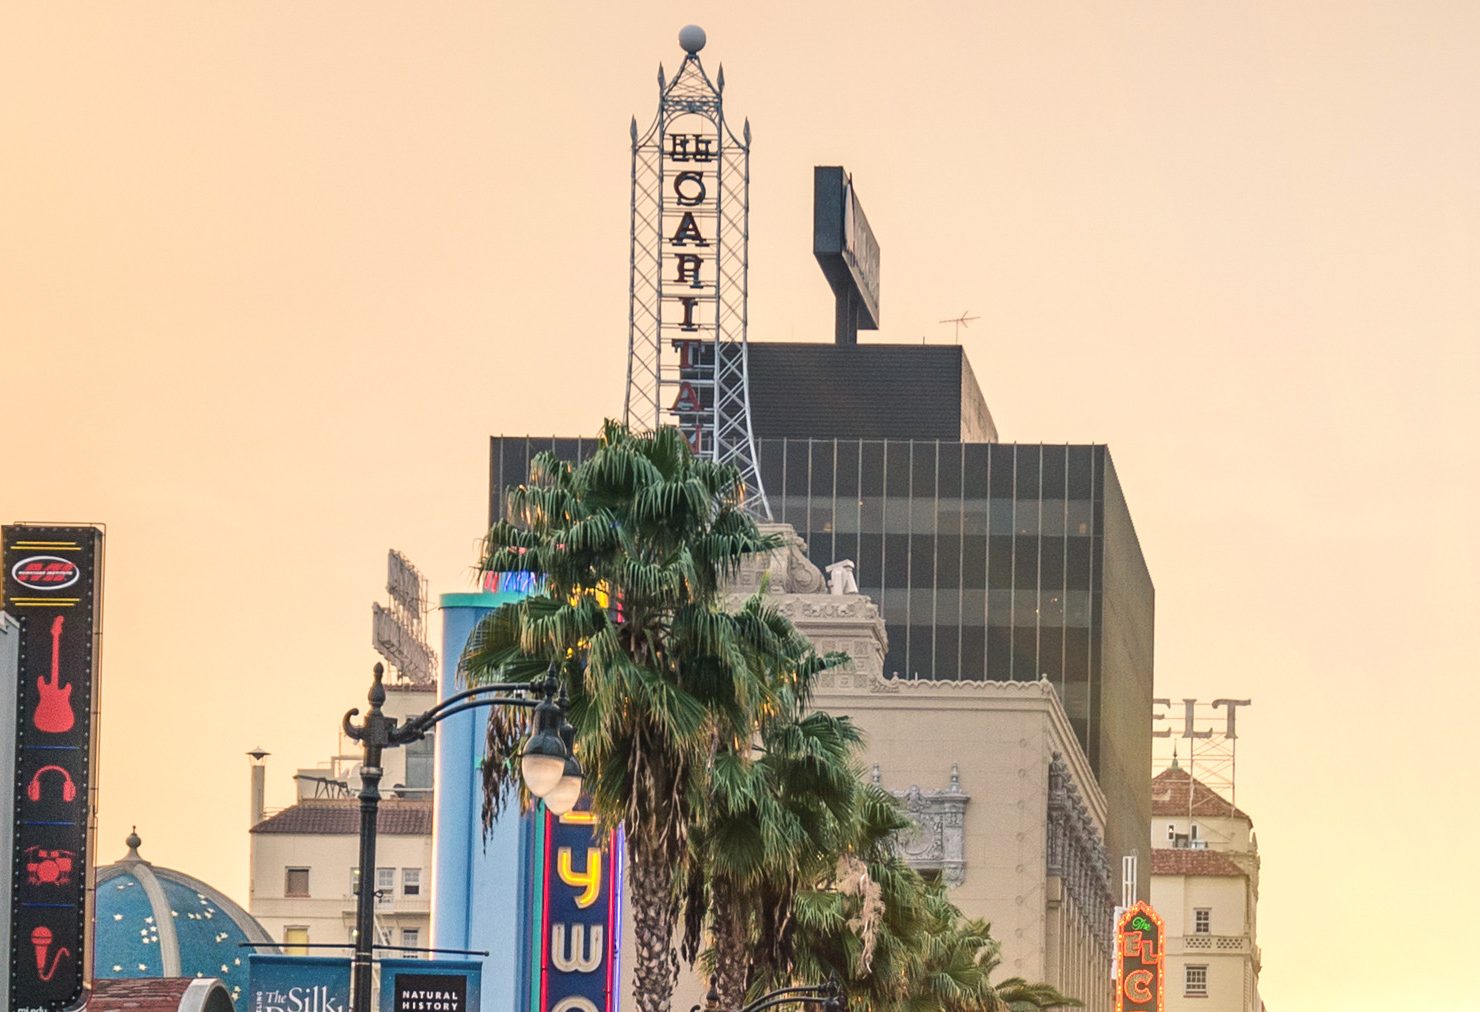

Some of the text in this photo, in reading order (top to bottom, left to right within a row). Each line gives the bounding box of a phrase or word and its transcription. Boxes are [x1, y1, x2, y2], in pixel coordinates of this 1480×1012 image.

[669, 133, 712, 162] EL
[1131, 916, 1151, 932] The
[1123, 931, 1159, 965] EL
[266, 990, 287, 1004] The
[402, 990, 458, 1000] NATURAL
[402, 1001, 458, 1011] HISTORY
